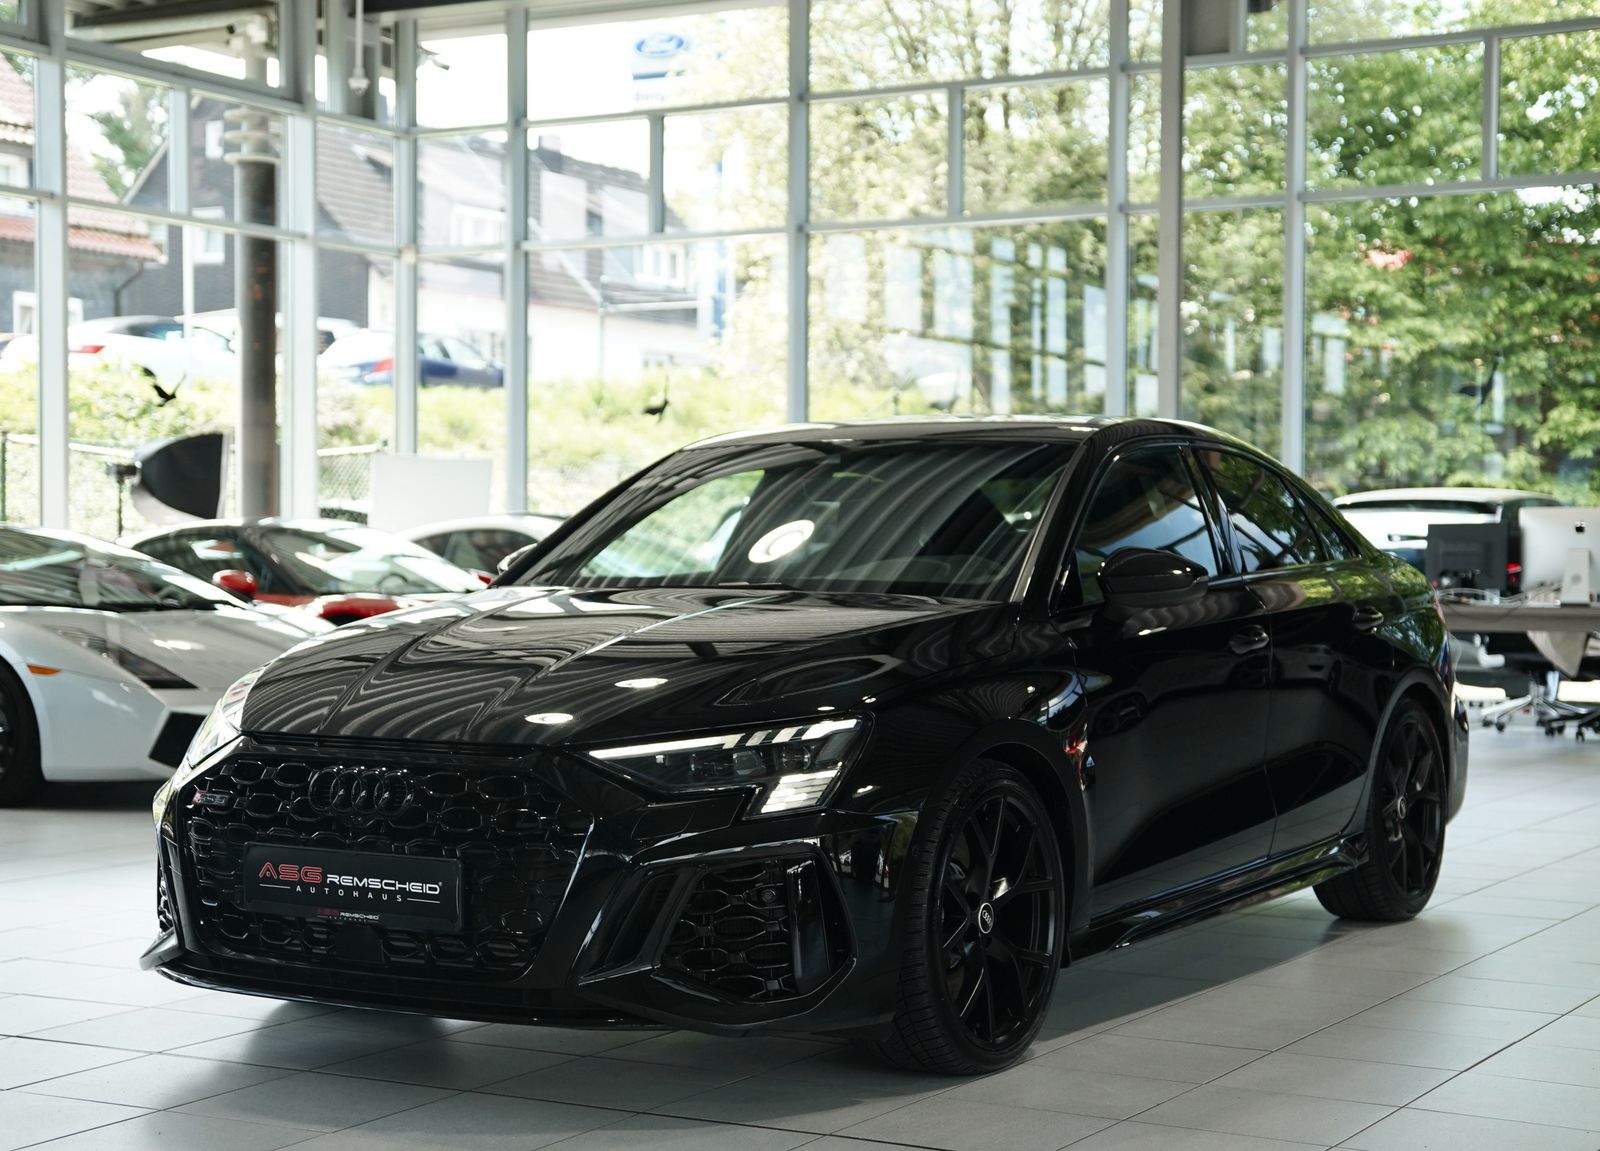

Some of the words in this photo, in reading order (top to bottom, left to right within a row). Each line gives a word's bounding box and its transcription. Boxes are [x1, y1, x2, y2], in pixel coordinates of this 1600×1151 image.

[258, 862, 323, 884] ASG
[326, 874, 441, 895] REMSCHEID
[296, 885, 403, 902] AUTOHAUS
